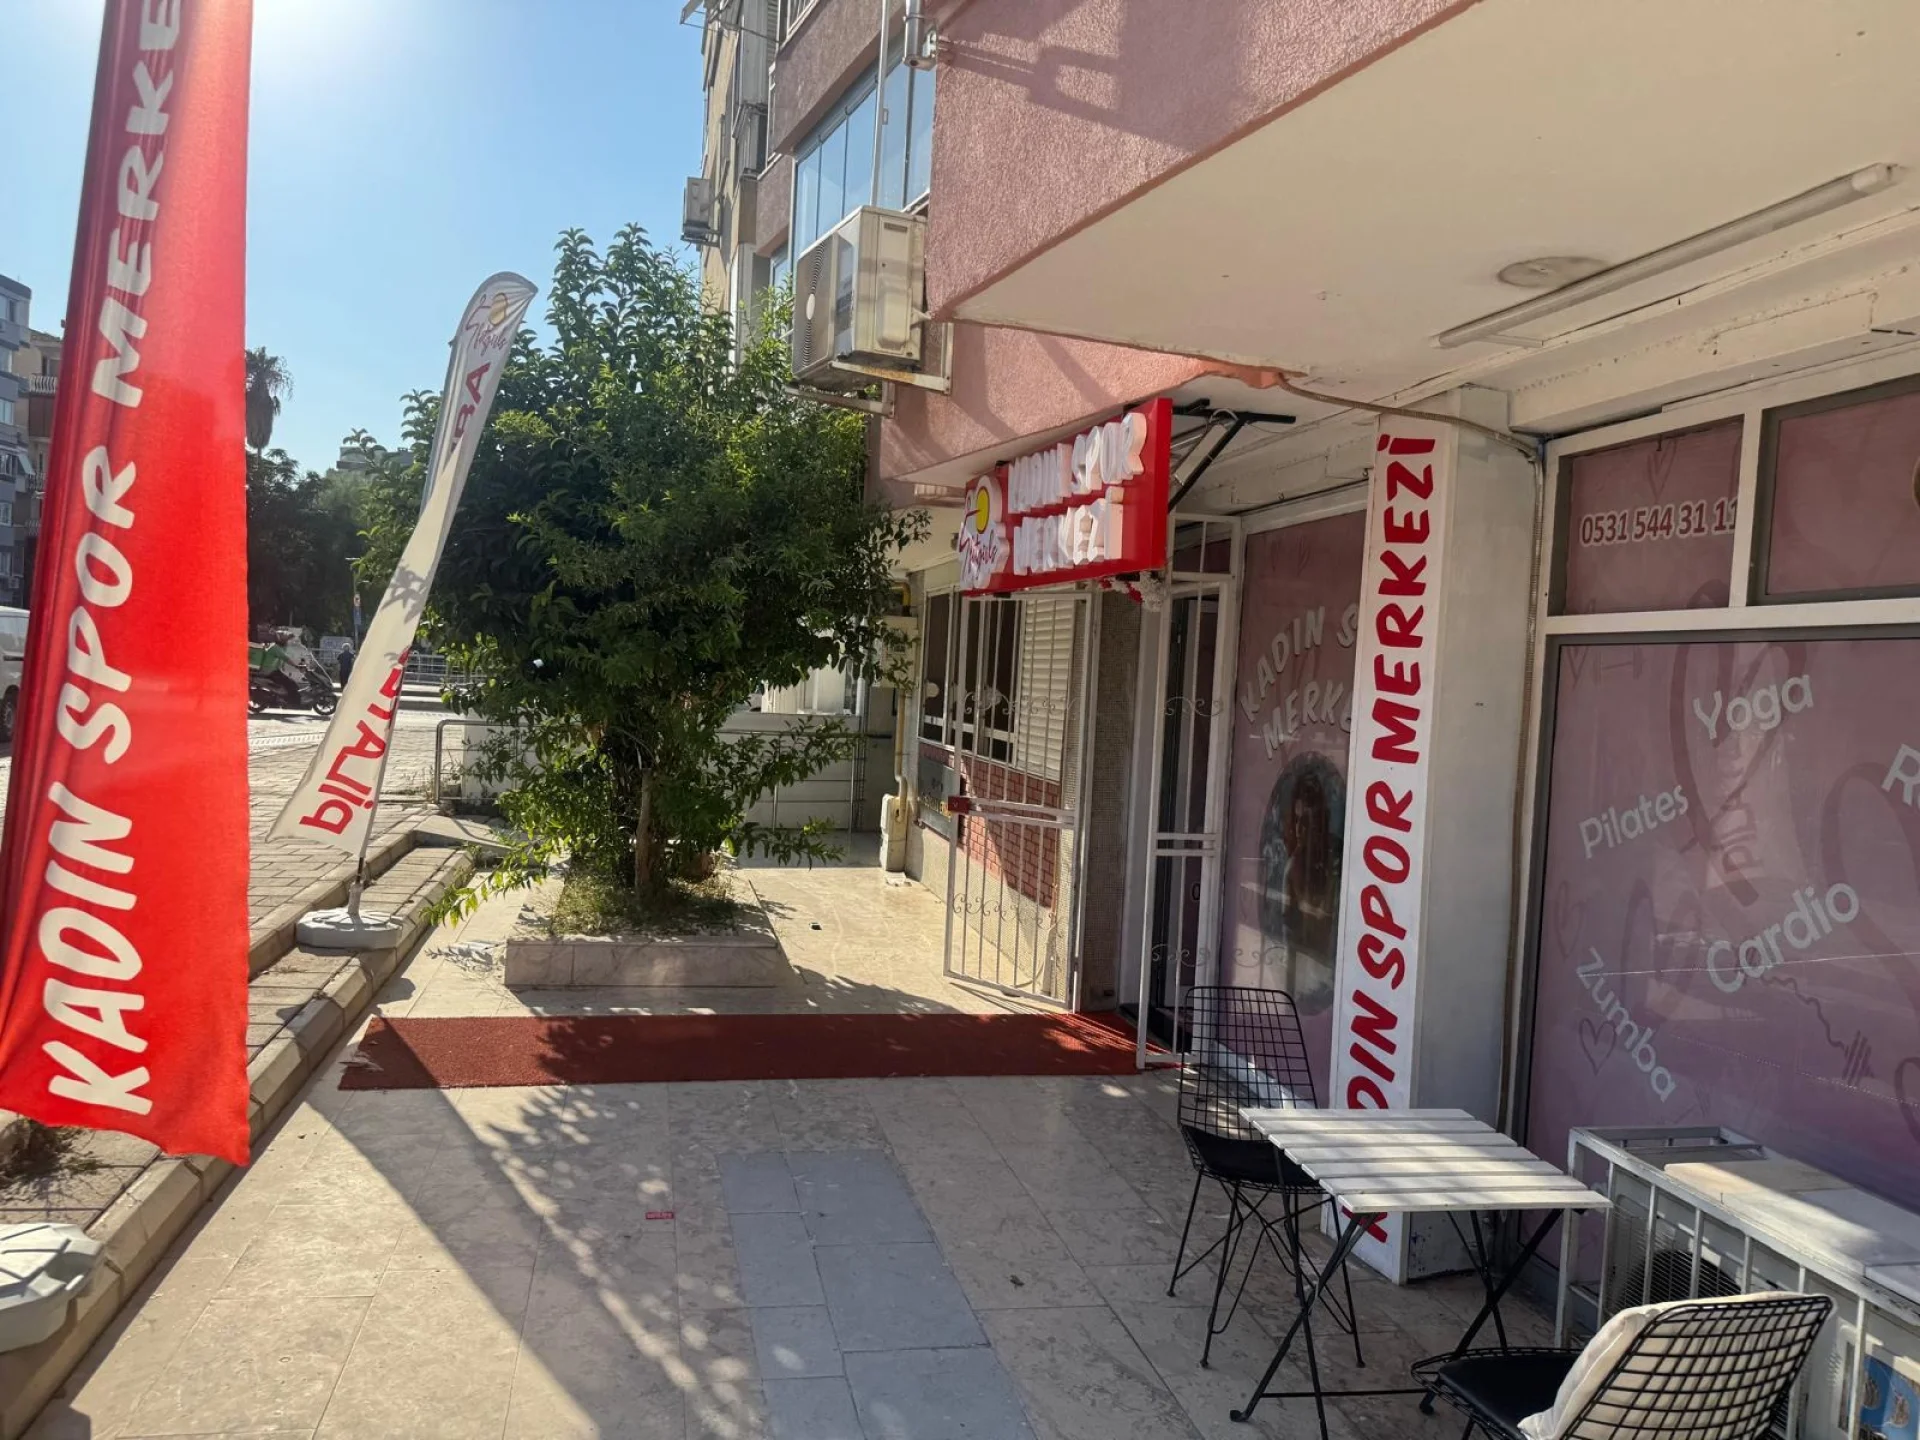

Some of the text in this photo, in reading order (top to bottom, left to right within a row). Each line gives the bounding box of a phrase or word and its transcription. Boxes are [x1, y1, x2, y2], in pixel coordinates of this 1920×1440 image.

[1580, 511, 1628, 547] 0531
[1632, 502, 1675, 541] 544
[1679, 501, 1707, 537] 31
[55, 444, 137, 765] SPOR
[1240, 605, 1325, 723] KADIN
[1372, 434, 1436, 766] MERKEZİ
[1693, 673, 1814, 741] Yoga
[1357, 779, 1413, 990] SPOR
[1578, 785, 1688, 858] Pilates
[38, 781, 153, 1115] KADIN
[1707, 882, 1859, 994] Cardio
[1577, 948, 1677, 1102] Zumba
